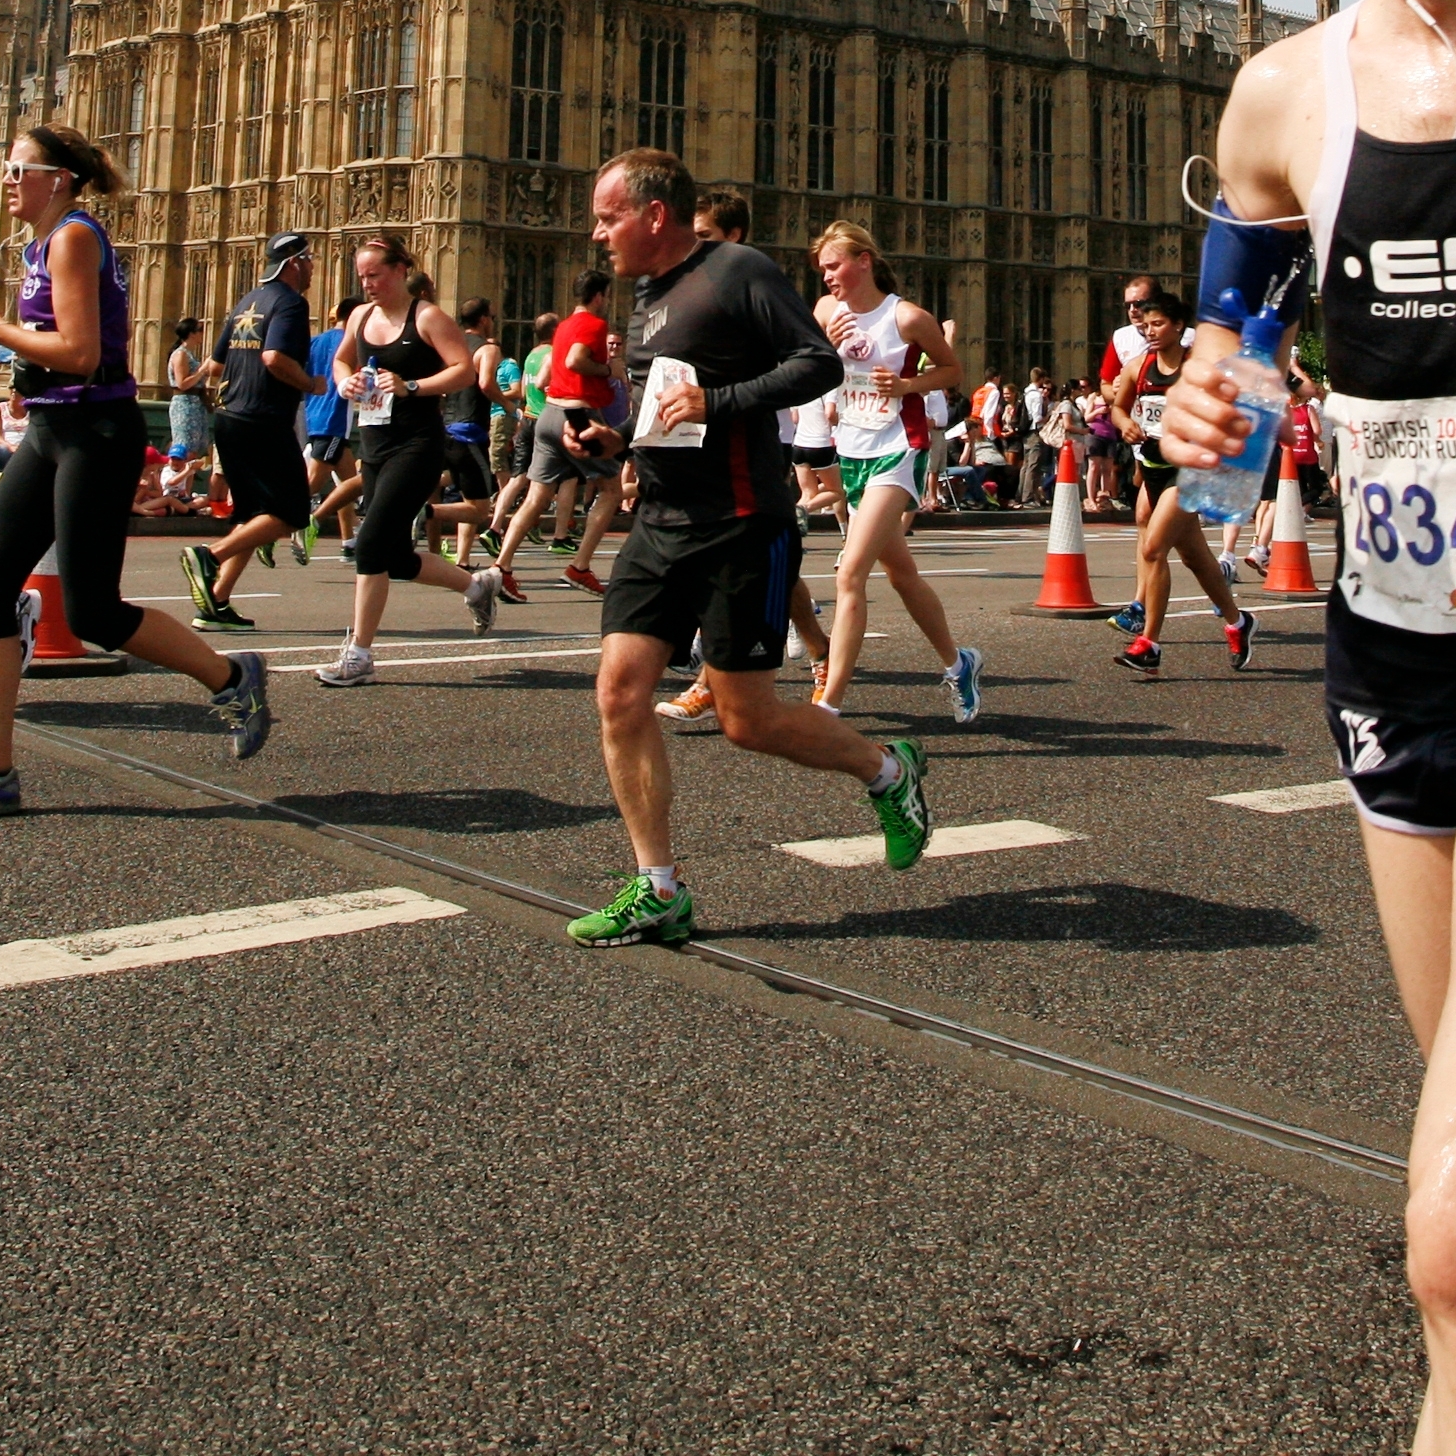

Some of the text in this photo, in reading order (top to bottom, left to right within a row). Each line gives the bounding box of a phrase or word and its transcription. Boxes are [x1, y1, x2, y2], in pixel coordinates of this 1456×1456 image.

[642, 305, 668, 345] RUN
[842, 389, 891, 413] 11072
[1362, 419, 1431, 441] BRITISH
[1365, 439, 1430, 460] LONDON
